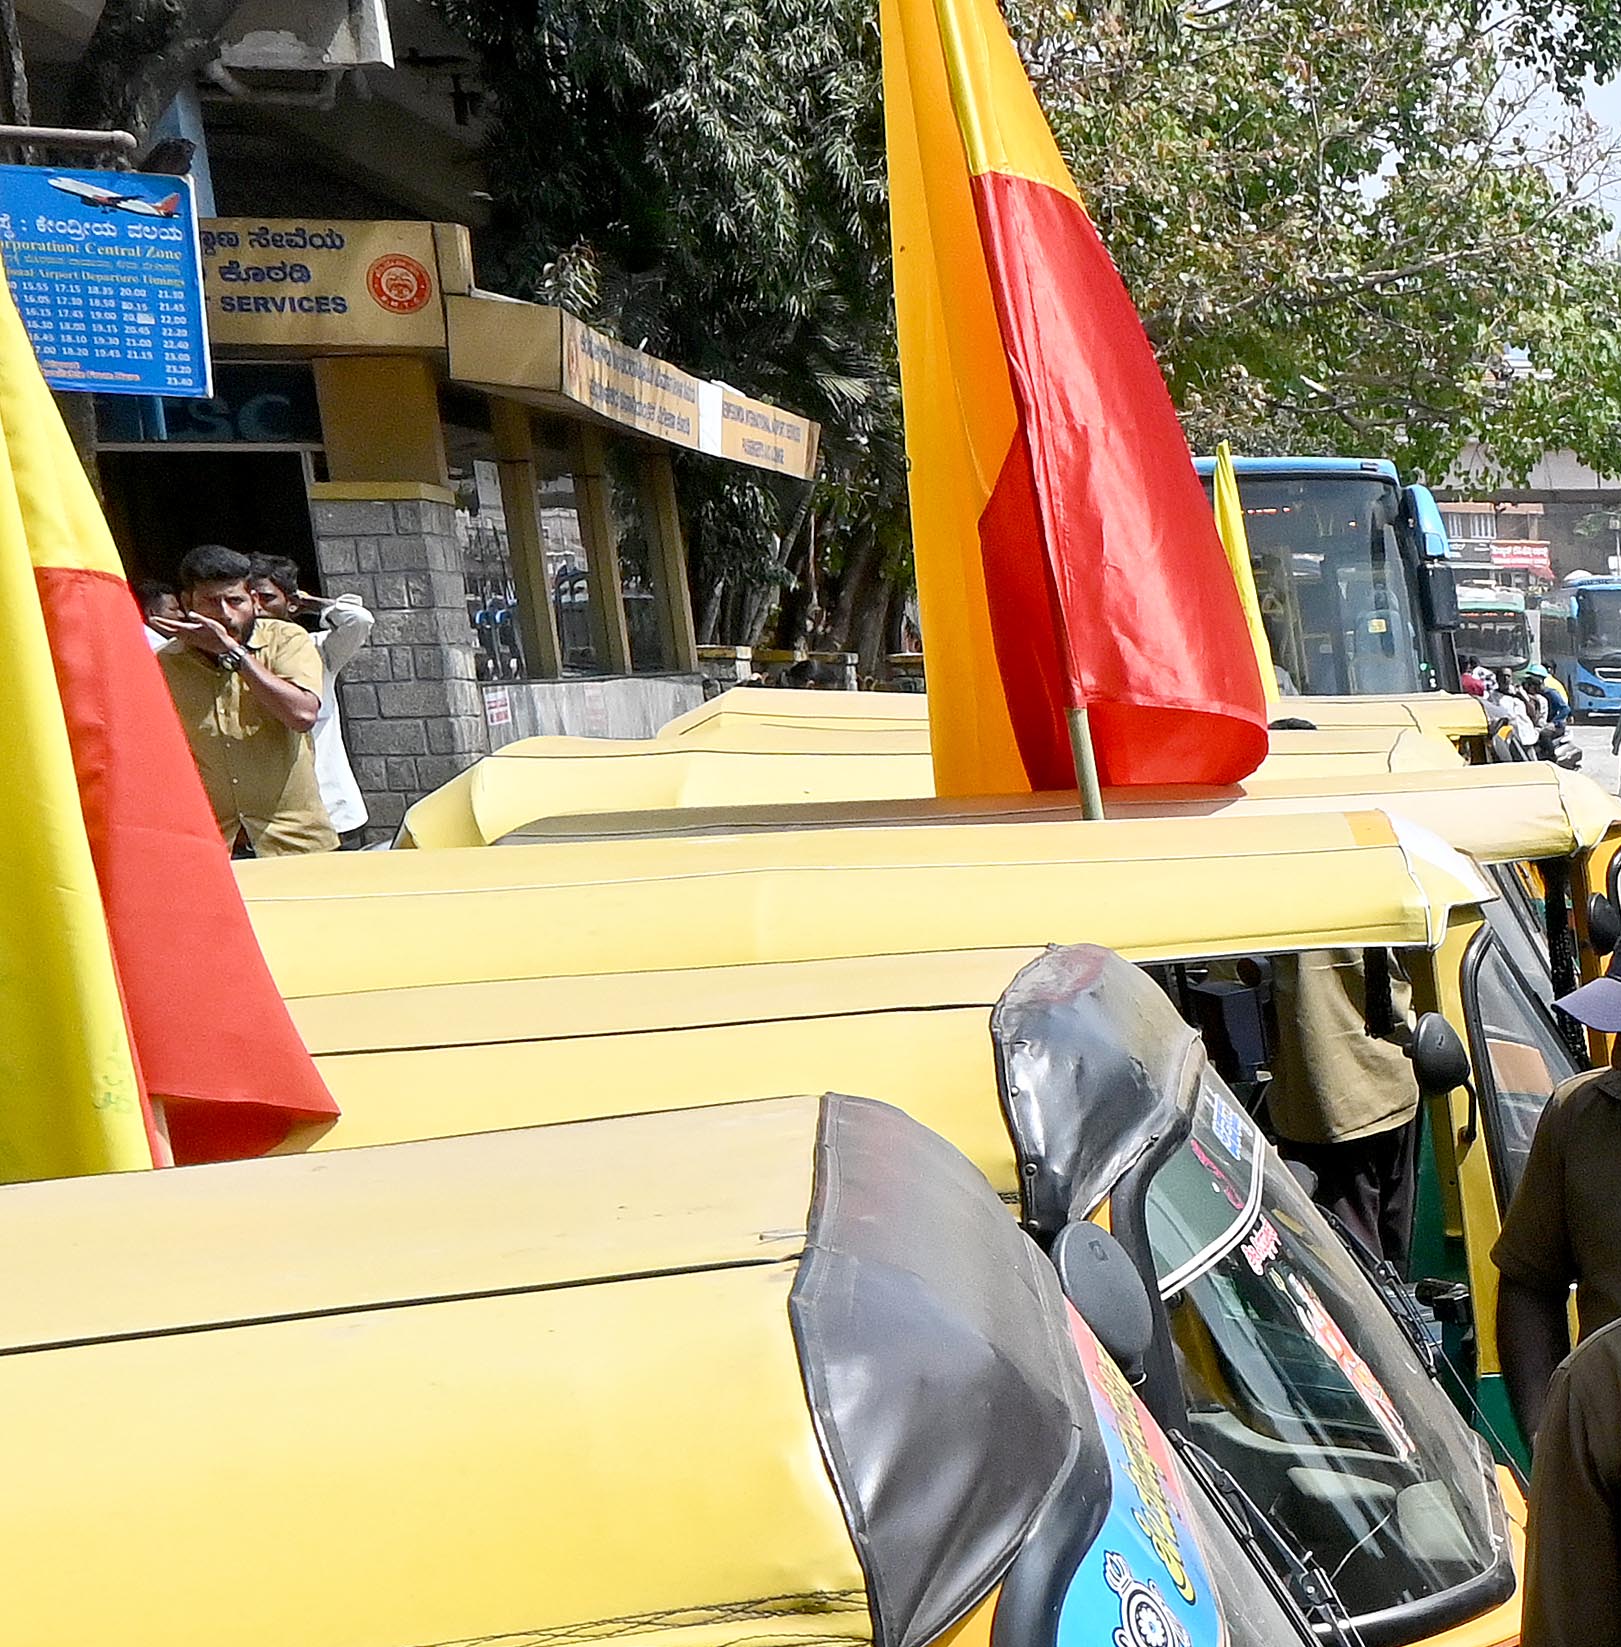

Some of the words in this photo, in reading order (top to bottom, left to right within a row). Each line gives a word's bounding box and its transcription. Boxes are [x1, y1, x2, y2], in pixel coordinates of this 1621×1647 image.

[127, 222, 183, 241] ವಲಯ
[85, 242, 142, 258] Central
[145, 246, 182, 260] Zone
[218, 260, 312, 283] ಕೊಠಡಿ
[221, 296, 348, 314] SERVICES
